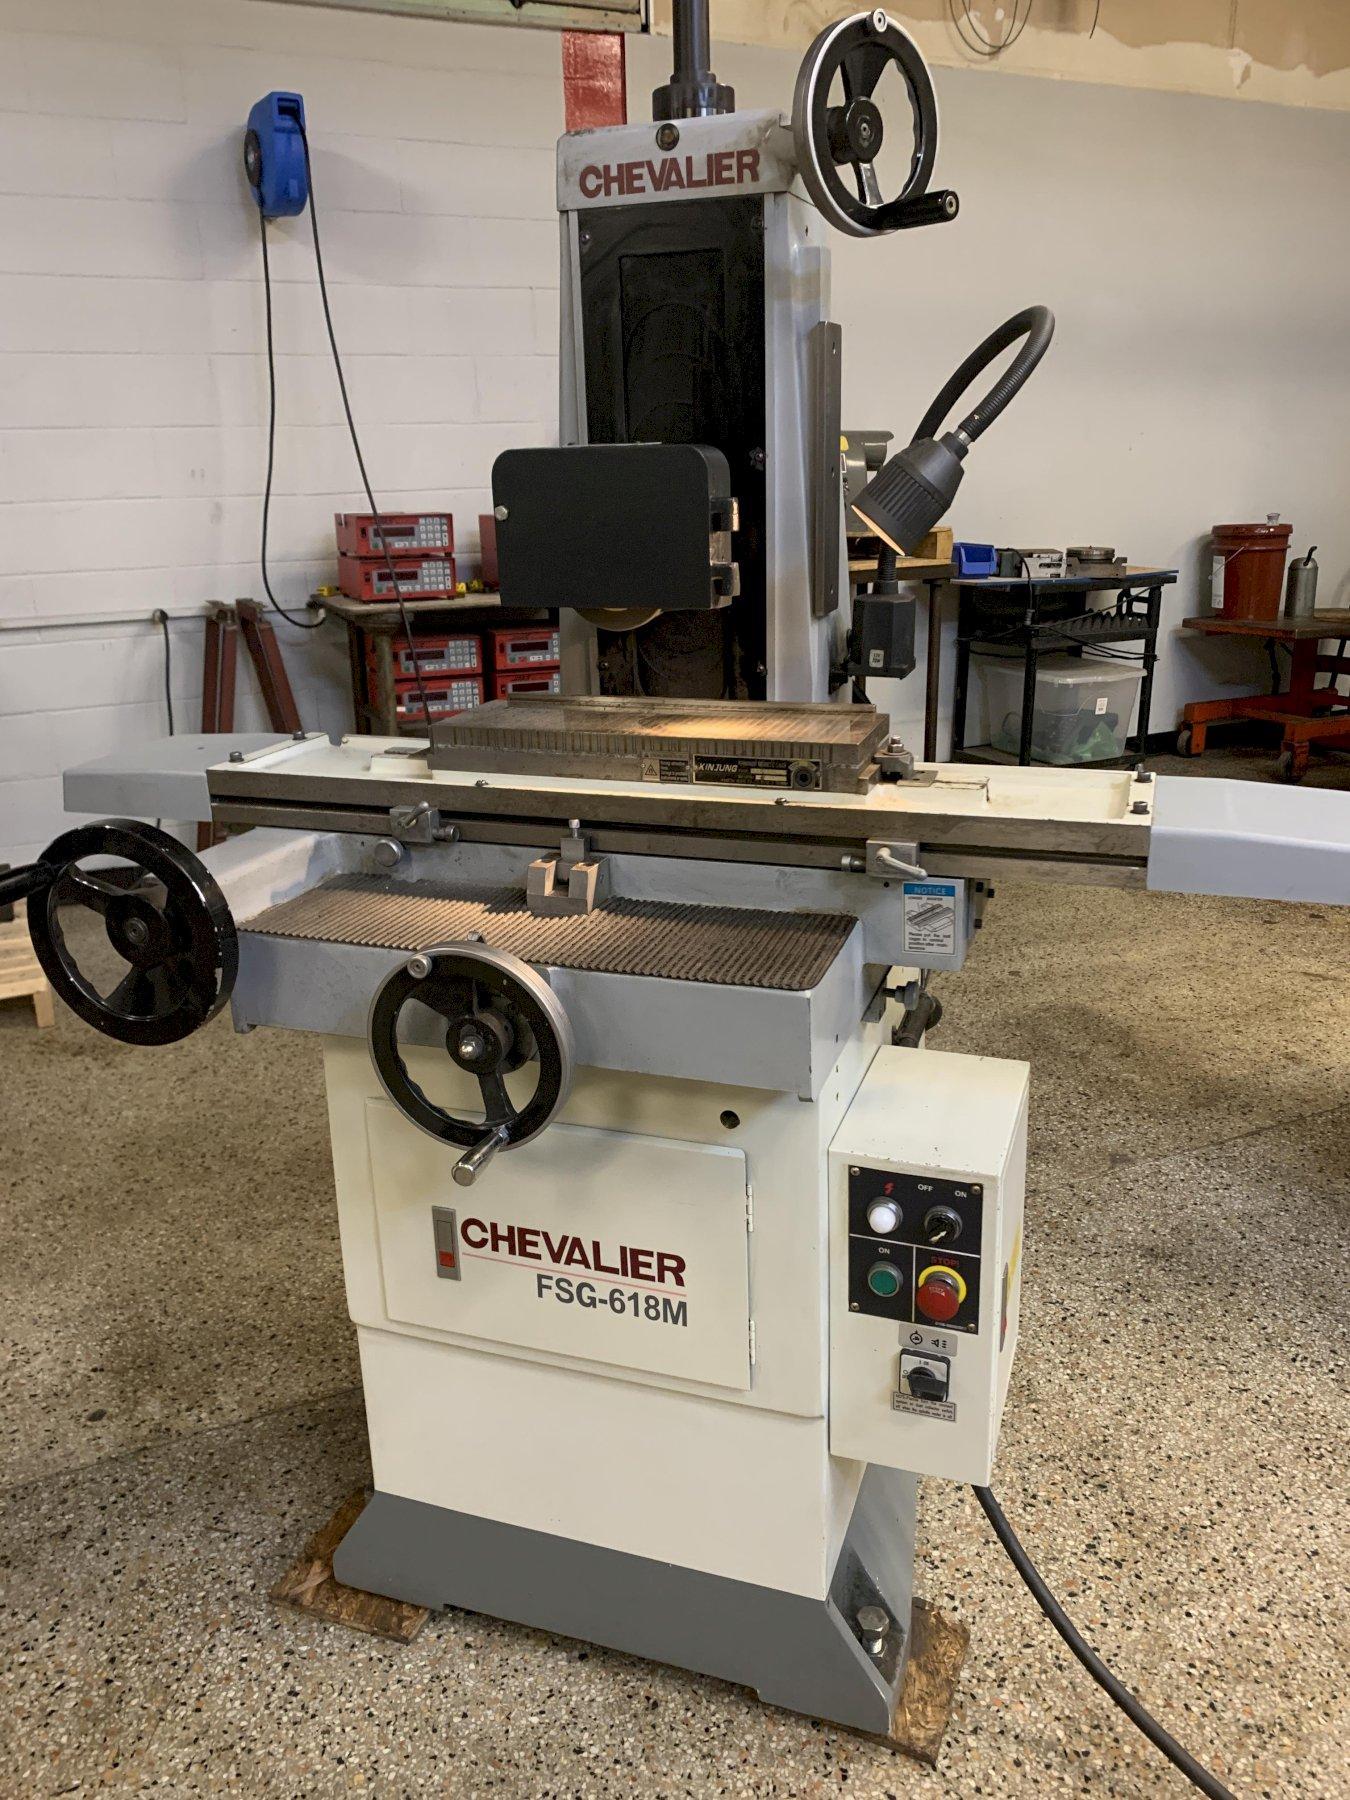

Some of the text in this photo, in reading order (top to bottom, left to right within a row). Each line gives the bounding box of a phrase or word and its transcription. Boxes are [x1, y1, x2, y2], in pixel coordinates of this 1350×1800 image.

[580, 150, 760, 199] CHEVALIER
[700, 762, 738, 773] KINJUNG
[914, 886, 946, 895] NOTICE
[917, 1183, 934, 1192] OFF
[954, 1190, 967, 1198] ON
[460, 1218, 686, 1287] CHEVALIER
[536, 1273, 688, 1327] FSG-618M
